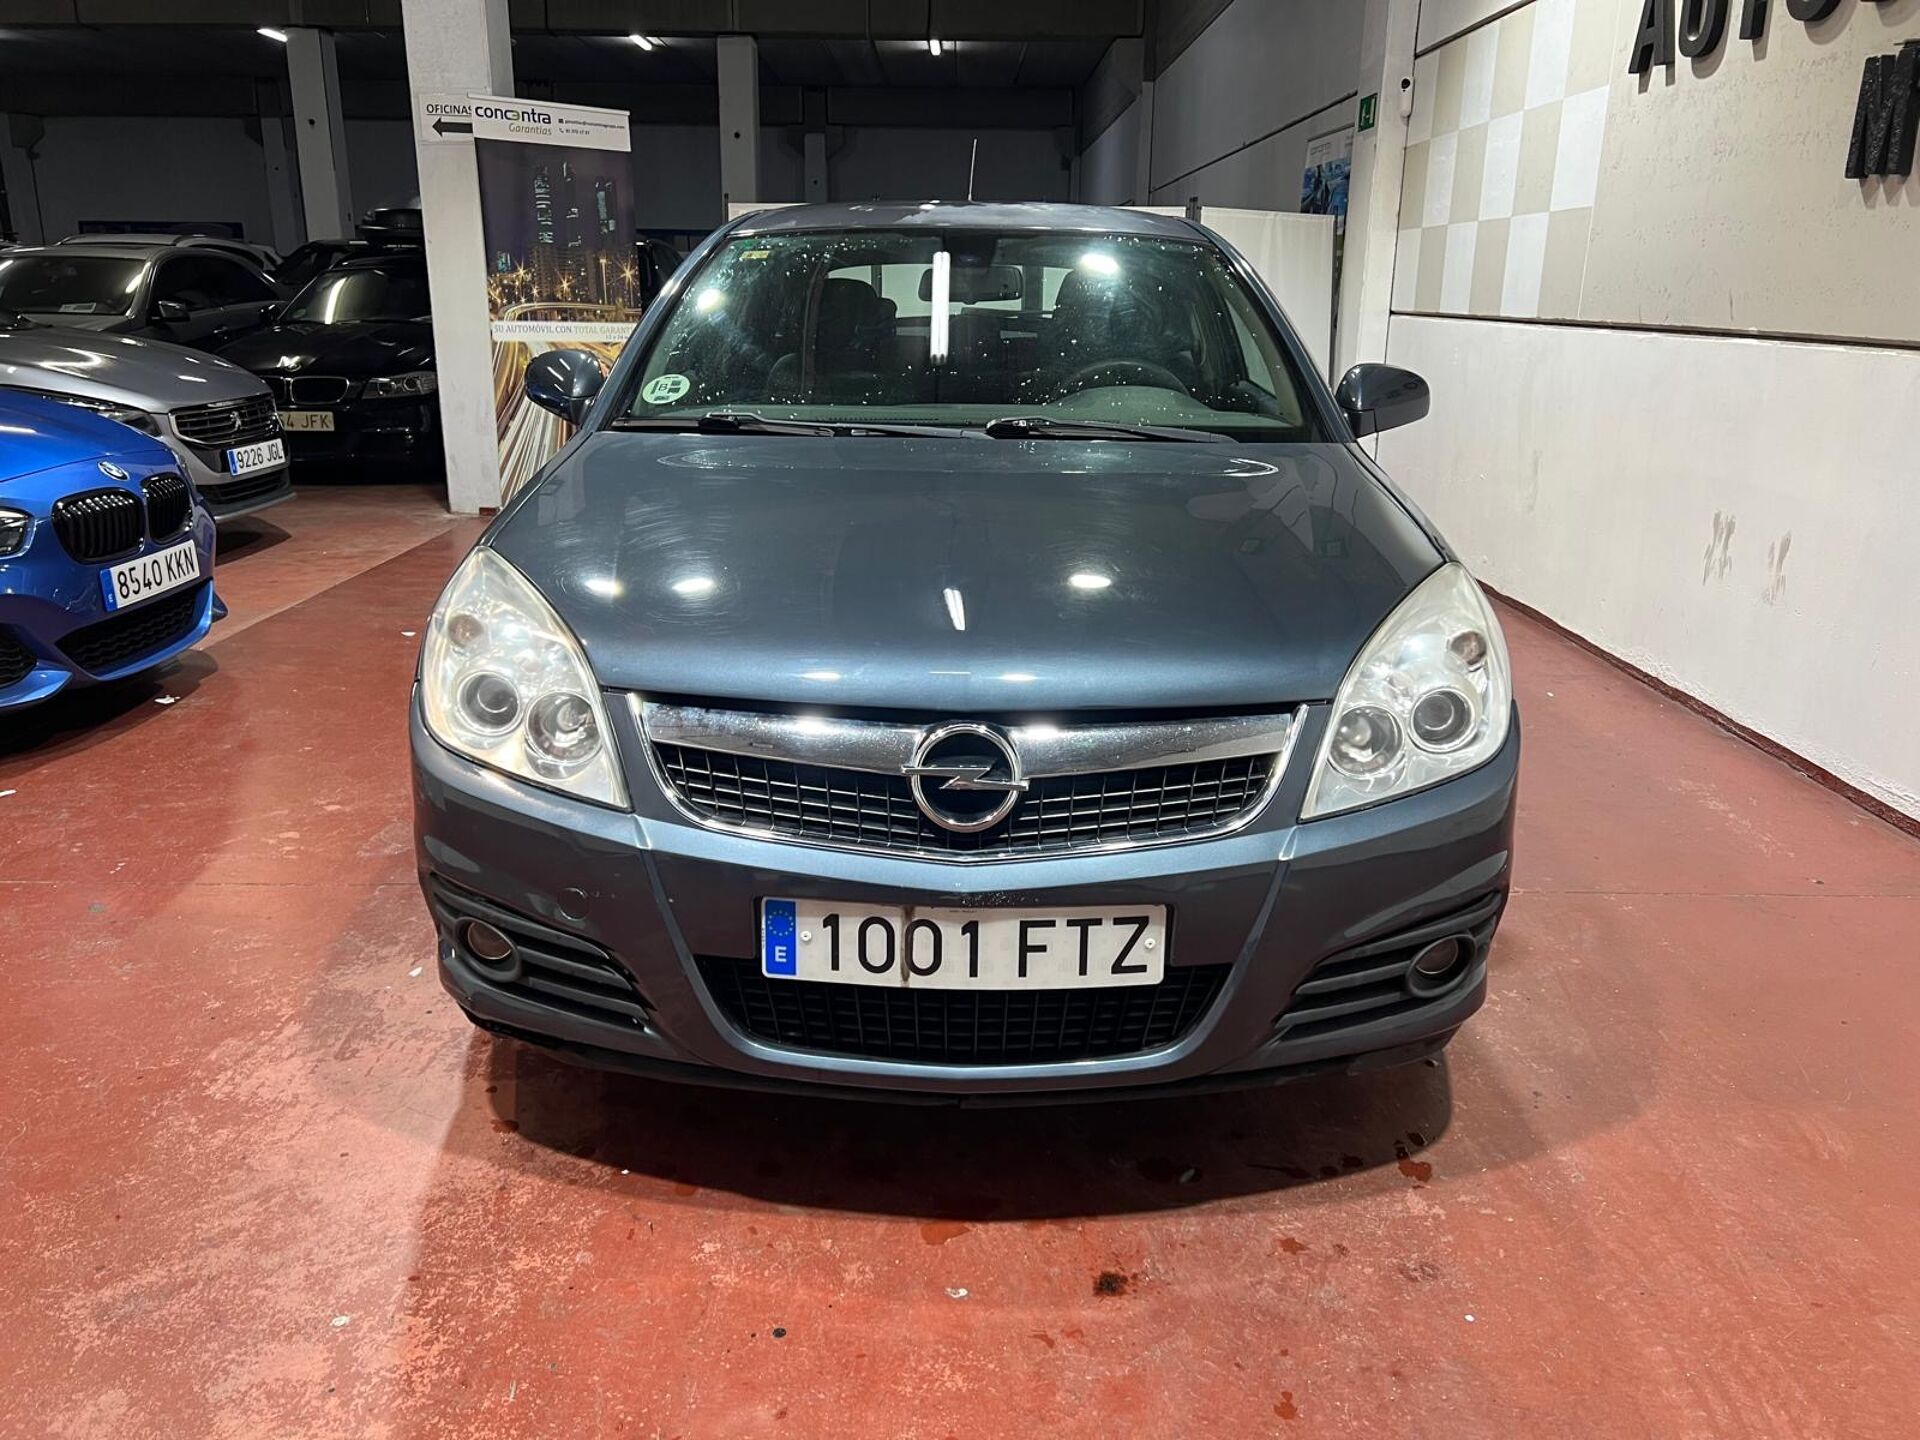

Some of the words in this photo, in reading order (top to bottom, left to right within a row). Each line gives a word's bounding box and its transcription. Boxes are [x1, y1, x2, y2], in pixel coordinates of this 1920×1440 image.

[555, 324, 572, 334] CON
[300, 414, 331, 429] JFK
[236, 447, 265, 469] 9226
[266, 442, 284, 462] JGL
[117, 559, 163, 599] 8540
[165, 547, 196, 582] KKN
[774, 945, 787, 963] E
[822, 913, 980, 978] 1001
[1018, 915, 1151, 978] FTZ
